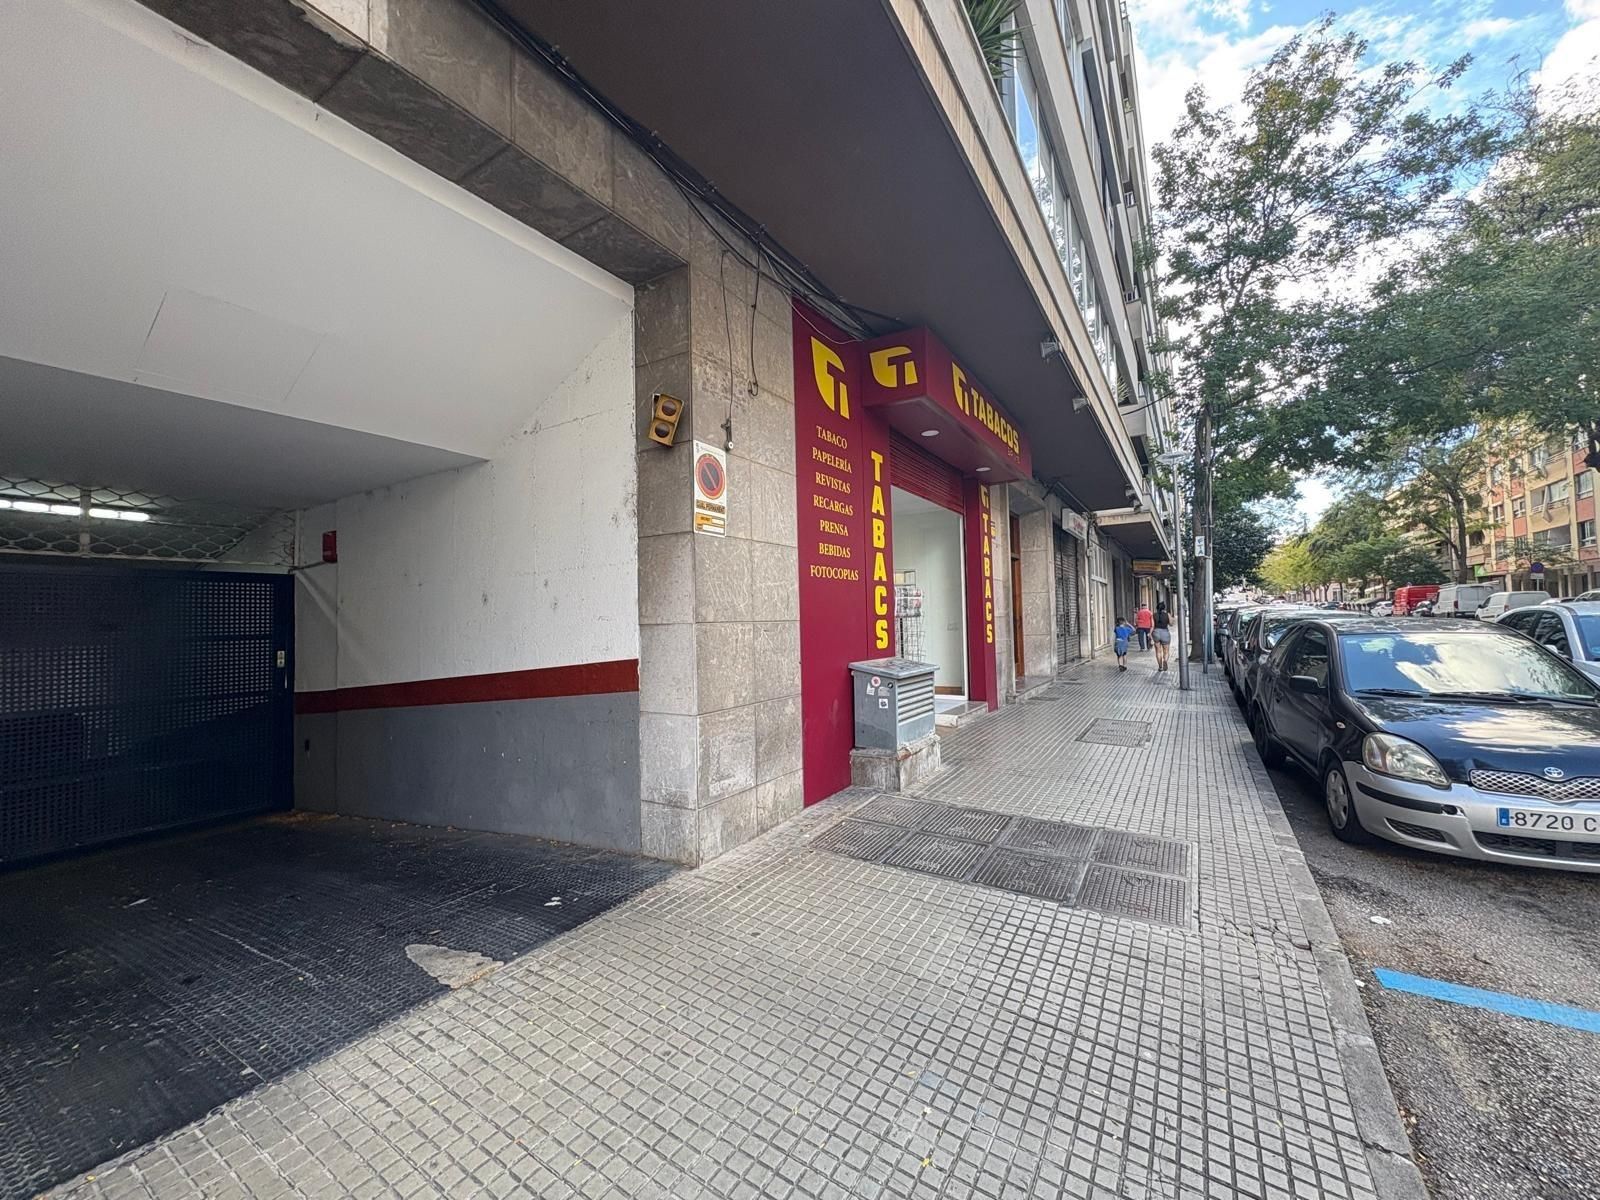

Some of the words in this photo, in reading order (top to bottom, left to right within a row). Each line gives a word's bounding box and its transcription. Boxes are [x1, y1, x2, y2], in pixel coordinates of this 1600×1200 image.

[970, 387, 1020, 455] TABACOS
[816, 425, 848, 449] TABACO
[812, 446, 852, 473] PAPELERÍA
[815, 471, 851, 494] REVISTAS
[813, 494, 854, 516] RECARGAS
[820, 519, 849, 537] PRENSA
[818, 542, 851, 559] BEBIDAS
[870, 450, 890, 650] TABACS
[810, 564, 859, 581] FOTOCOPIAS
[982, 513, 994, 644] TABACS
[1514, 811, 1574, 831] 8720
[1583, 816, 1597, 832] C
